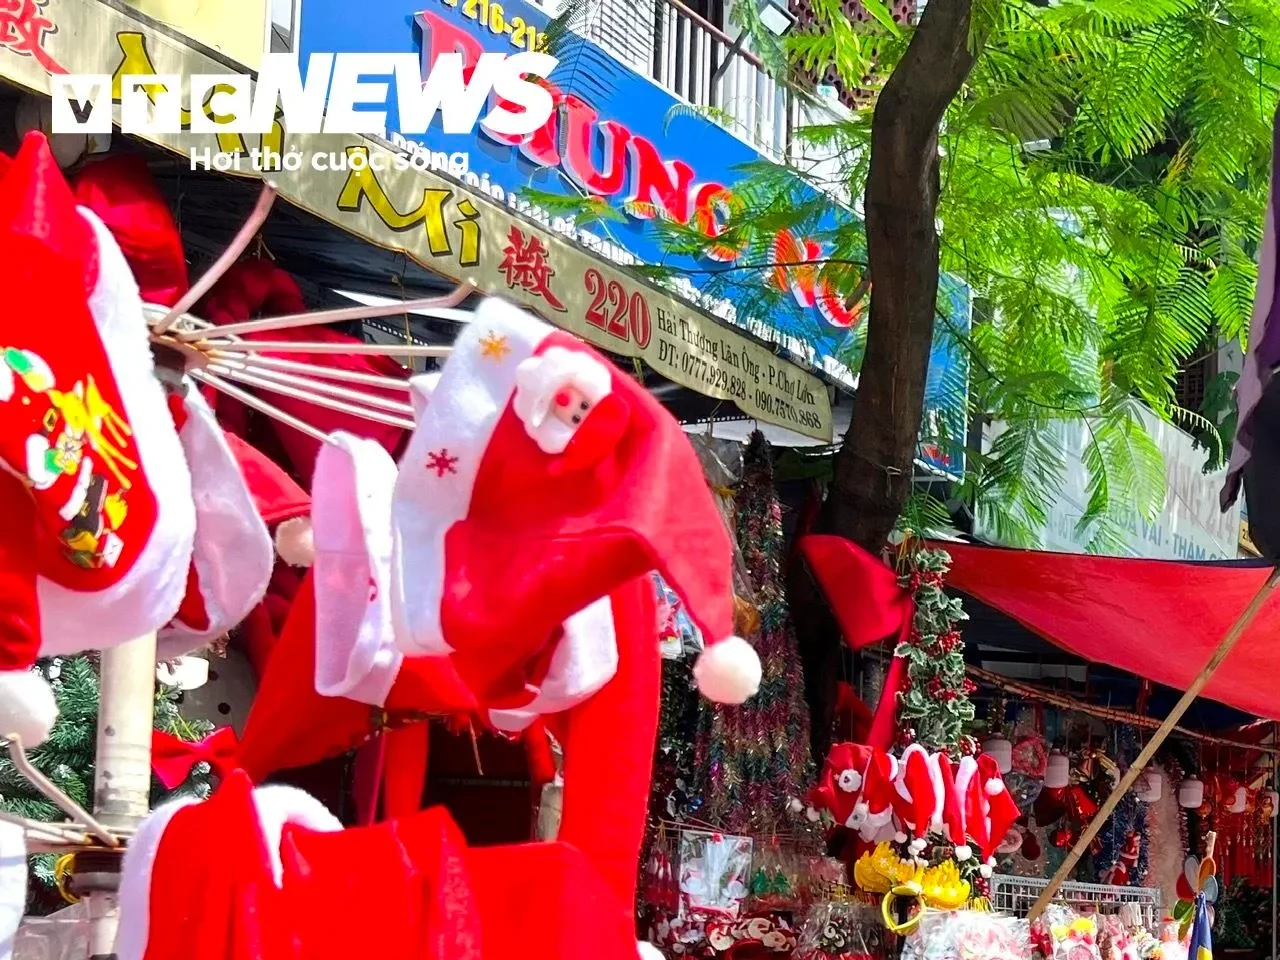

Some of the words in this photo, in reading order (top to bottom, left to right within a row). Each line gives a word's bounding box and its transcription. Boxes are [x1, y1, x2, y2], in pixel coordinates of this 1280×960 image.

[336, 145, 480, 267] Mi
[584, 267, 652, 350] 220
[658, 338, 679, 370] ĐT:
[681, 351, 747, 401] 0777.929.828
[754, 388, 822, 430] 090.7570.868
